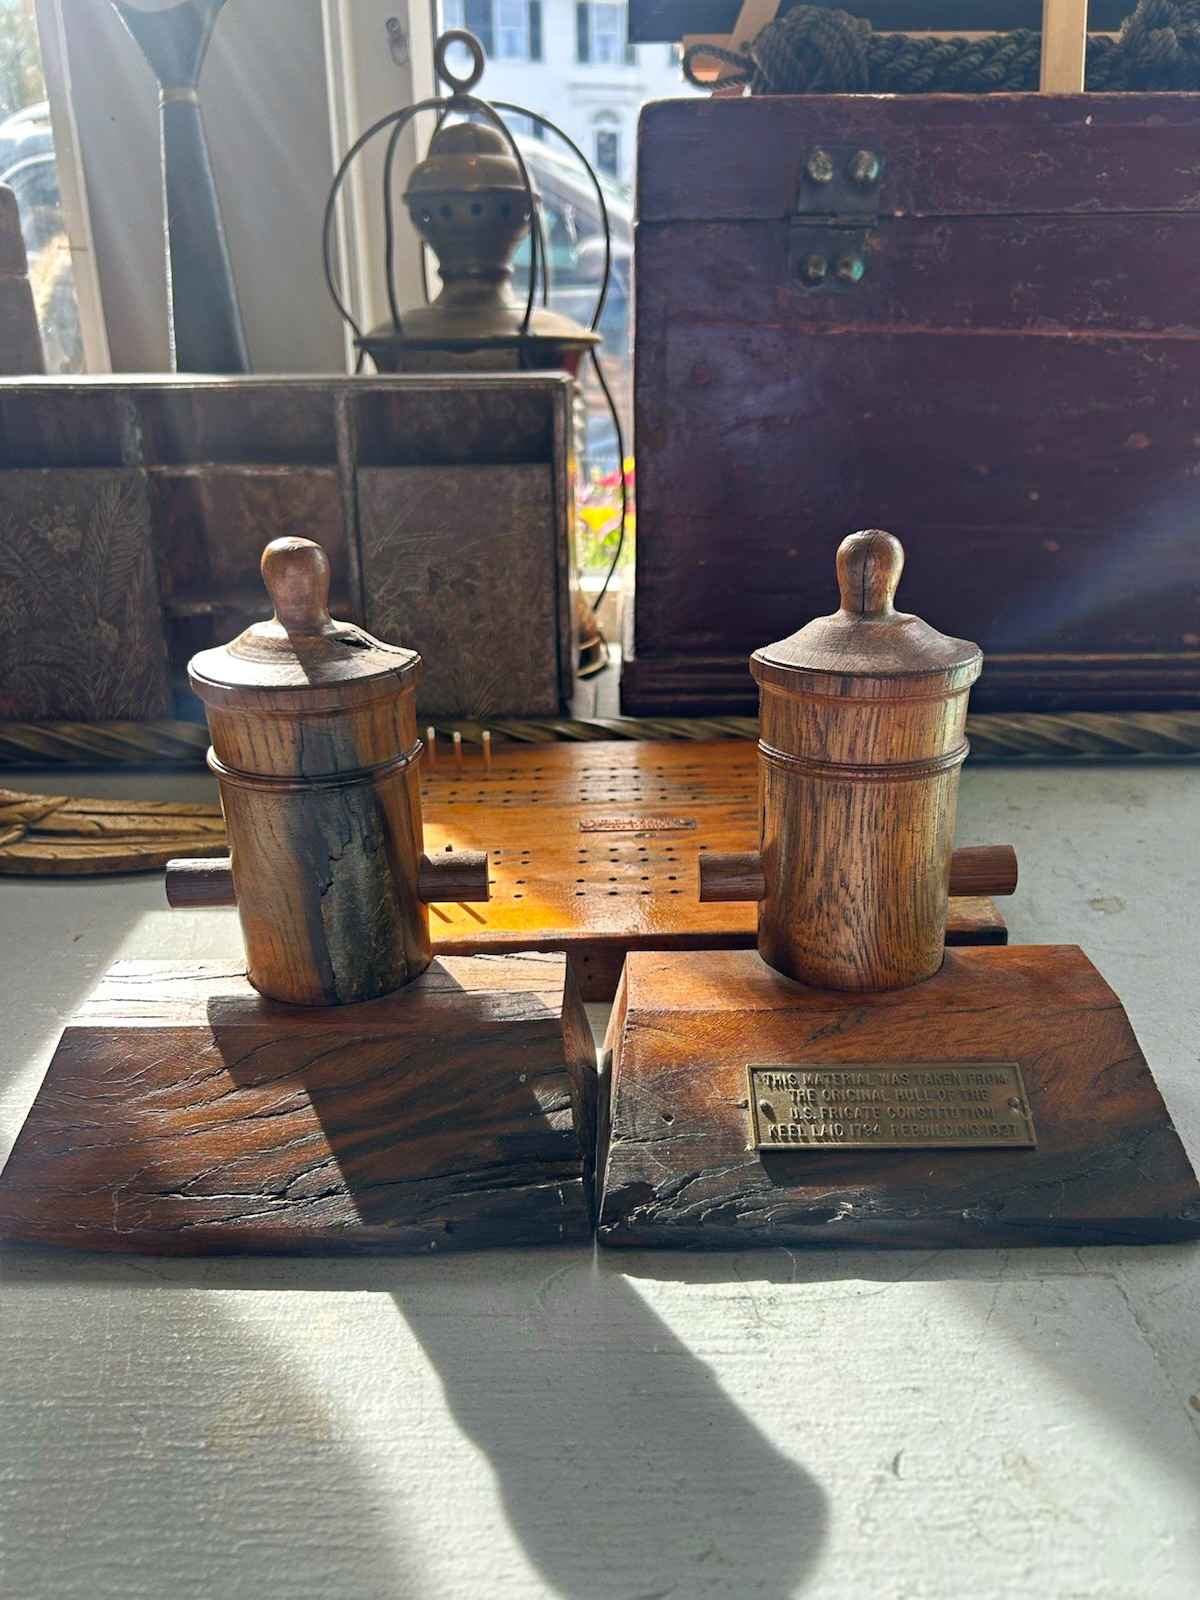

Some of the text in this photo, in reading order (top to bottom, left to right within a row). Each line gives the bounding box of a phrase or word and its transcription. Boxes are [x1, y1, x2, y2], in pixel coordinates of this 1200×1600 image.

[762, 1072, 1008, 1086] THIS MATERIAL WAS TAKEN FROM
[787, 1088, 989, 1101] THE ORIGINAL HULL OF THE
[789, 1106, 996, 1119] U.S. FRIGATE CONSTITUTION
[768, 1123, 1017, 1137] KEEL LAID 1794 REBUILDING 1927
